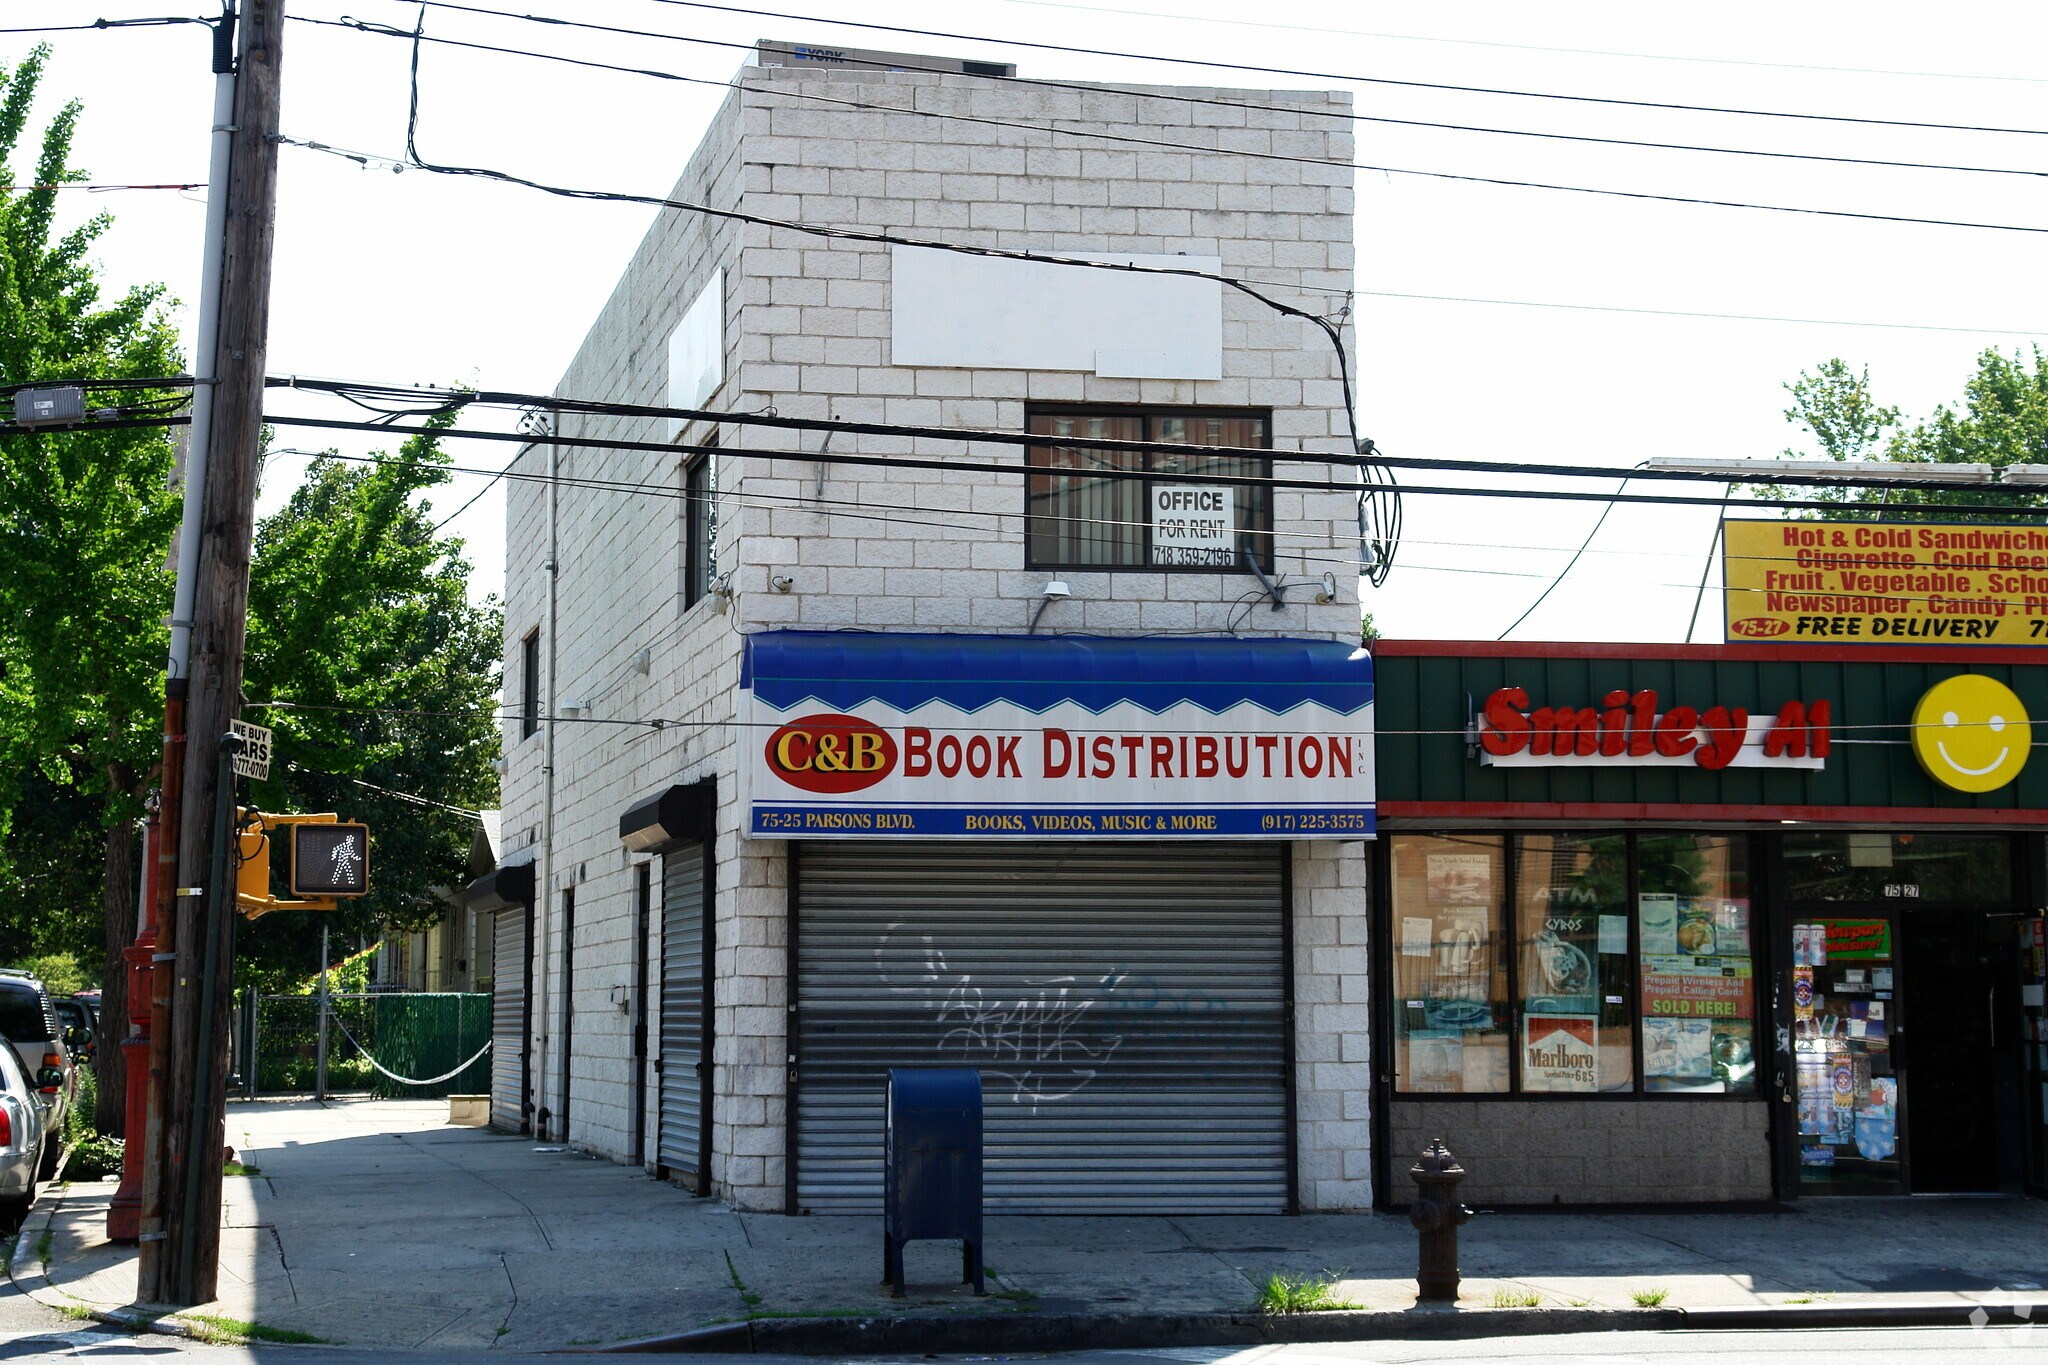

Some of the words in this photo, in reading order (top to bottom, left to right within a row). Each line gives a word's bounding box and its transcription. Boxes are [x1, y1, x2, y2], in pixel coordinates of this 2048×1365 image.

[817, 48, 854, 63] YORK
[1158, 491, 1223, 511] OFFICE
[1159, 519, 1186, 538] FOR
[1190, 520, 1225, 538] RENT
[1784, 527, 1826, 547] Hot
[1831, 531, 1848, 547] &
[1855, 528, 1912, 548] Cold
[1154, 547, 1173, 565] 718
[1178, 547, 1231, 566] 359-2196
[1797, 549, 1915, 571] Cigarette
[1934, 551, 1990, 571] Cold
[1997, 552, 2048, 572] Bee
[1766, 571, 1824, 590] Fruit
[1840, 572, 1970, 594] Vegetable
[1767, 591, 1910, 615] Newspaper
[1928, 594, 2007, 617] Candy
[1739, 620, 1783, 634] 75-27
[1796, 616, 1862, 636] FREE
[1872, 618, 2000, 639] DELIVERY
[234, 723, 246, 737] WE
[249, 727, 267, 742] BUY
[1479, 687, 1748, 770] Smiley
[237, 739, 268, 762] ARS
[773, 730, 887, 774] C&B
[903, 727, 1023, 778] BOOK
[1043, 727, 1354, 778] DISTRIBUTION
[761, 814, 801, 828] 75-25
[806, 814, 871, 829] PARSONS
[876, 815, 915, 829] BLVD.
[965, 815, 1027, 831] BOOKS,
[1032, 816, 1096, 832] VIDEOS,
[1101, 815, 1151, 830] MUSIC
[1156, 816, 1167, 829] &
[1171, 815, 1217, 830] MORE
[1262, 815, 1296, 830] (917)
[1300, 815, 1365, 830] 225-3575
[1532, 888, 1598, 902] ATM
[1886, 885, 1900, 897] 75
[1905, 885, 1918, 897] 27
[1545, 918, 1582, 931] GYROS
[1644, 976, 1680, 986] Prepaid
[1682, 977, 1723, 986] Wireless
[1726, 978, 1744, 987] And
[1644, 986, 1680, 995] Prepaid
[1683, 986, 1715, 996] Calling
[1718, 987, 1744, 997] Cards
[1652, 999, 1690, 1014] SOLD
[1695, 1000, 1737, 1015] HERE!
[1529, 1044, 1593, 1068] Marlboro
[1544, 1071, 1561, 1079] Special
[1562, 1071, 1576, 1079] Price
